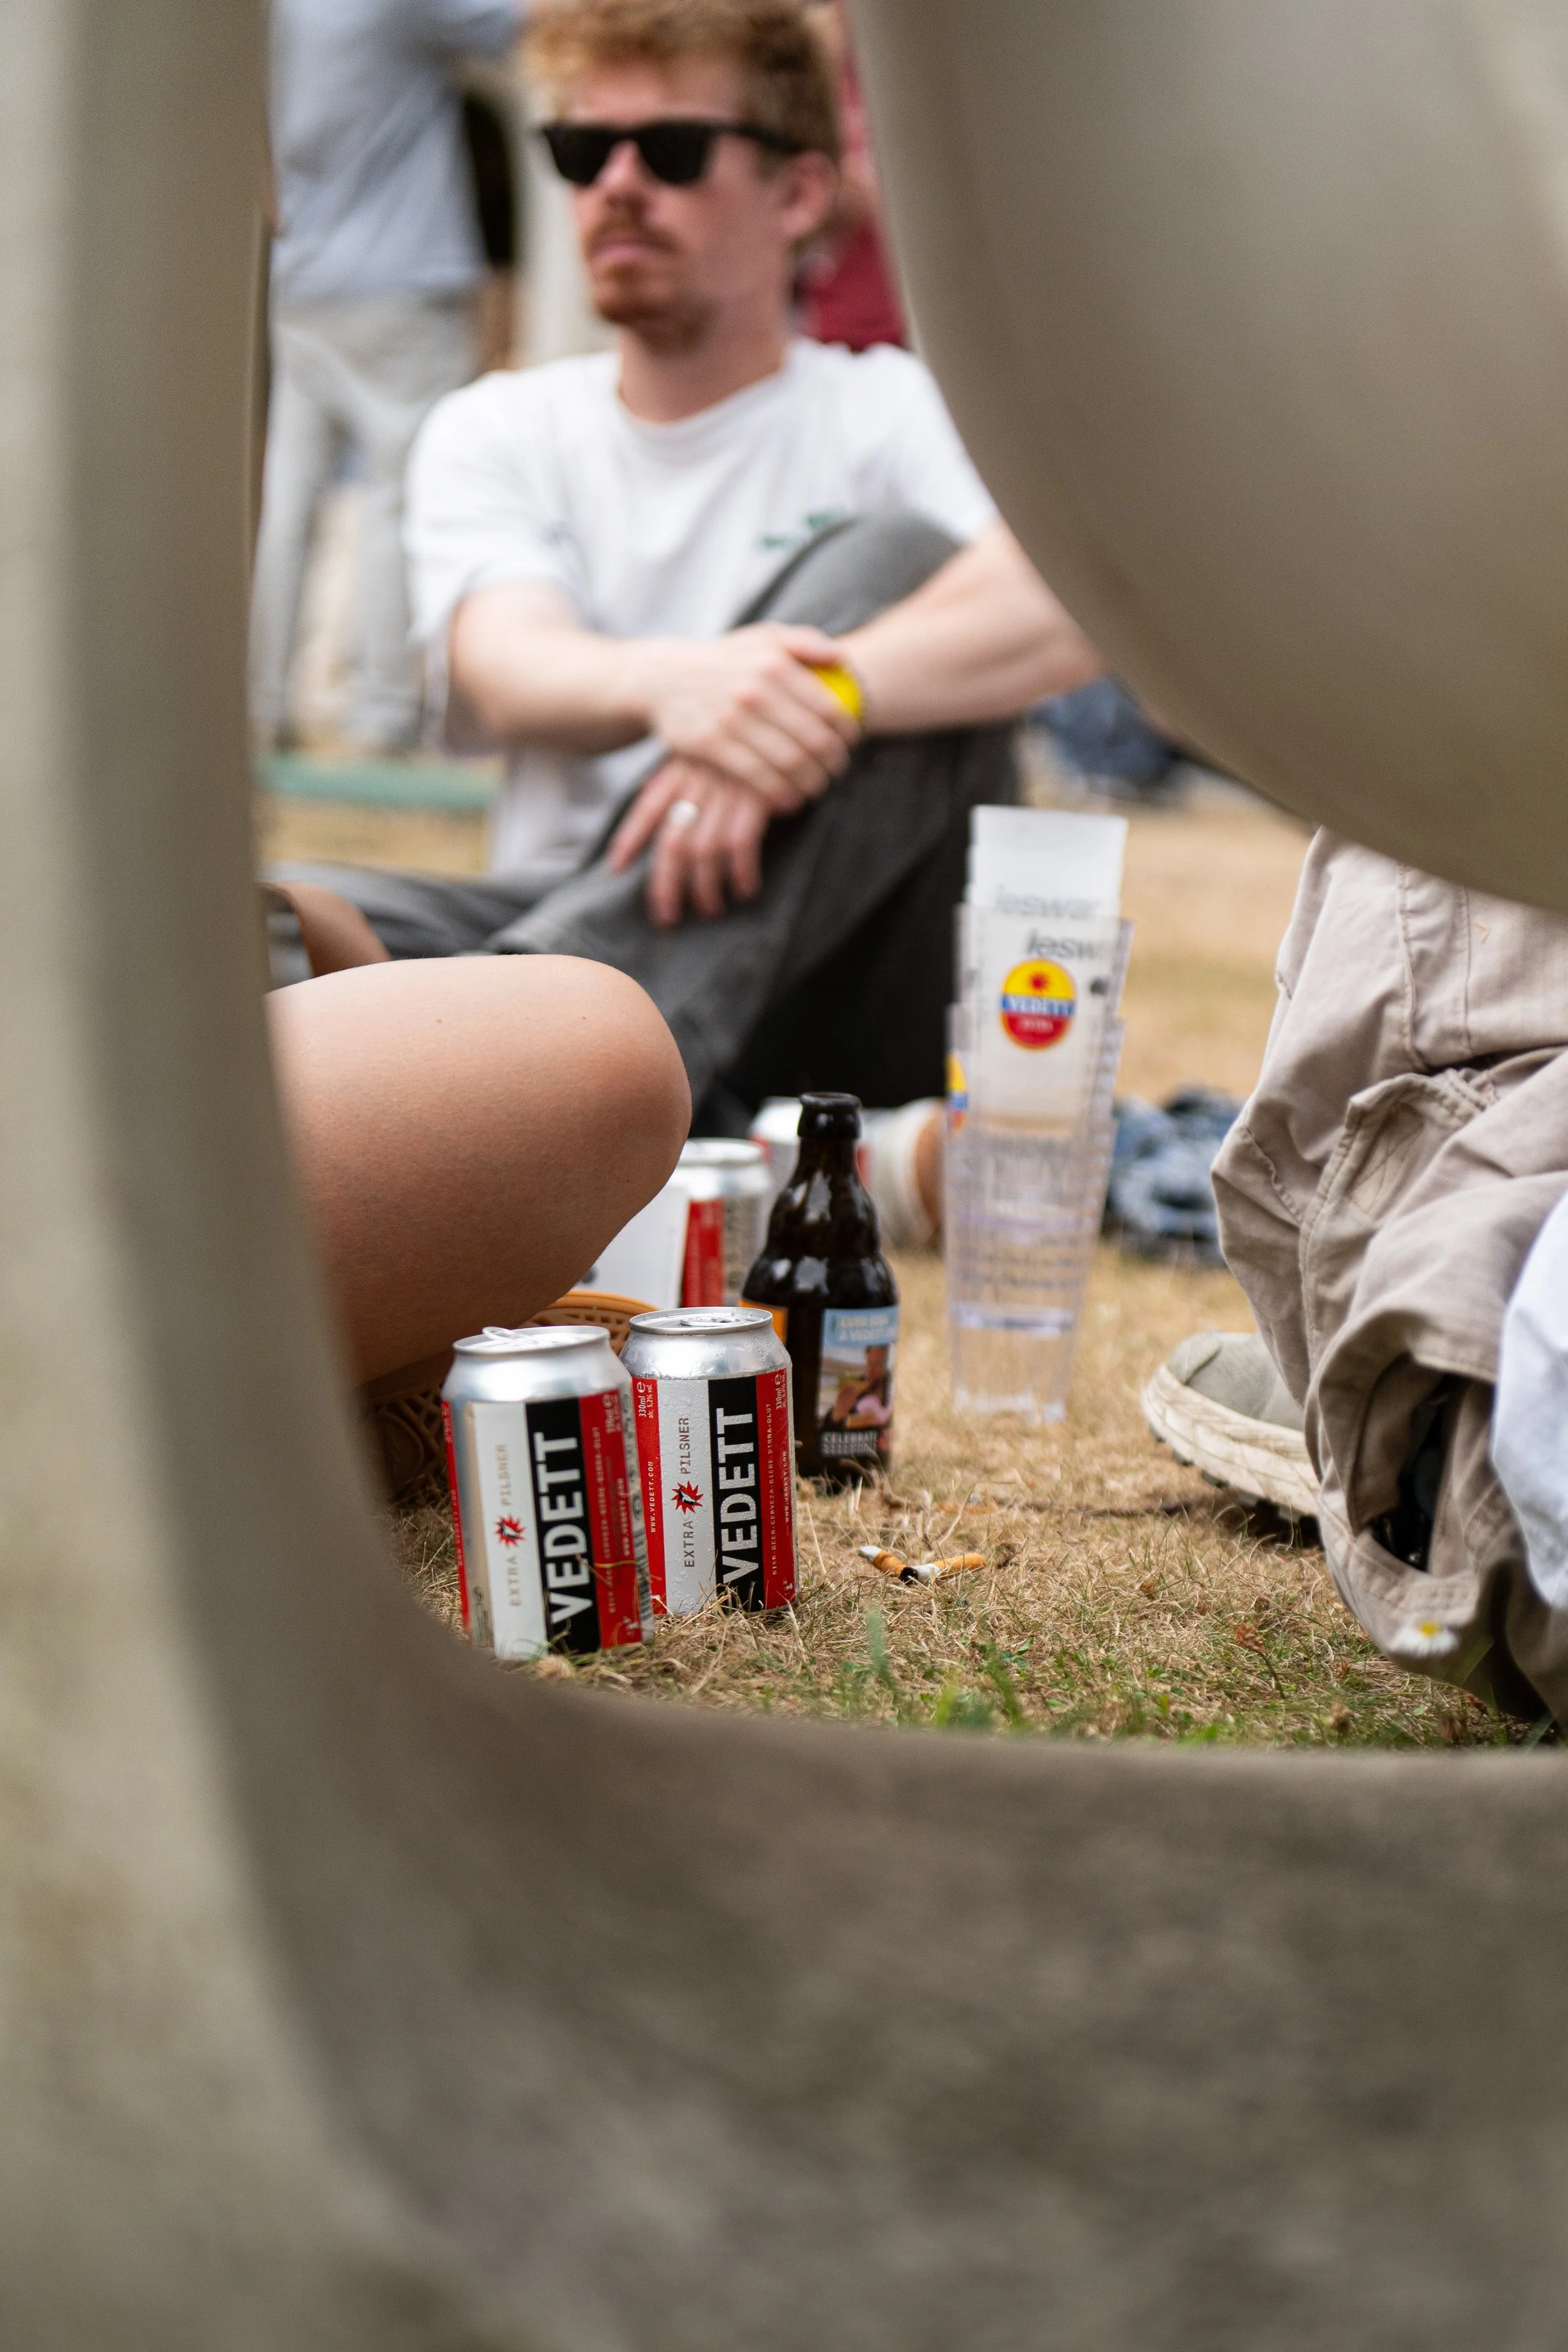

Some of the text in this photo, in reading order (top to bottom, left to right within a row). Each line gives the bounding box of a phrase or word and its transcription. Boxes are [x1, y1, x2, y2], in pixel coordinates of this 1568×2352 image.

[638, 1396, 647, 1417] 330ml
[495, 1444, 521, 1606] EXTRA PILSNER
[533, 1431, 593, 1624] VEDETT
[648, 1461, 656, 1533] WWW.VEDETT.COM
[679, 1417, 696, 1567] EXTRA PILSNER
[716, 1407, 759, 1584] VEDETT
